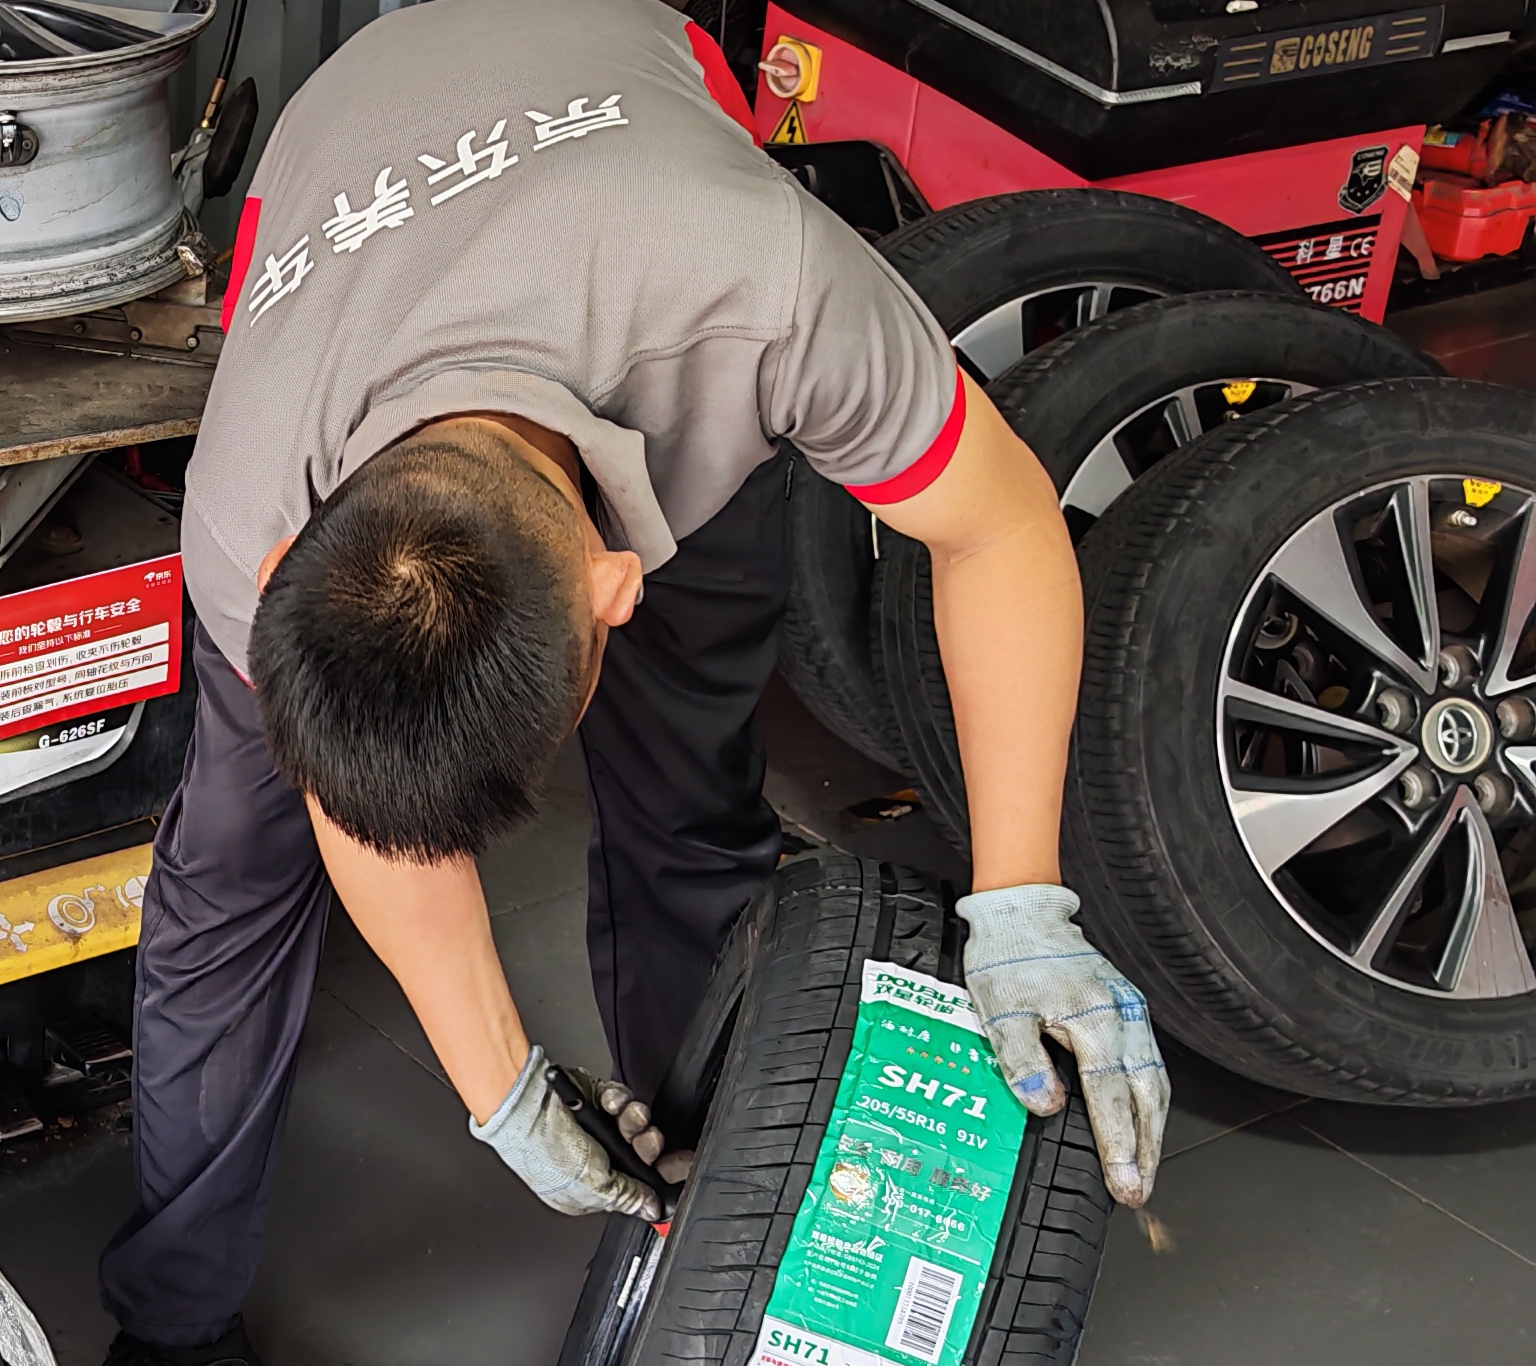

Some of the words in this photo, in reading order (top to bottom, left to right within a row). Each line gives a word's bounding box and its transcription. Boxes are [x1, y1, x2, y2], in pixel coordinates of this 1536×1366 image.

[1298, 25, 1375, 70] COSENG
[38, 719, 106, 749] G-626SF
[873, 983, 956, 1015] 双星轮胎
[877, 1064, 988, 1121] SH71
[855, 1095, 947, 1135] 205/55R16
[956, 1128, 988, 1150] 91V
[766, 1329, 831, 1366] SH71
